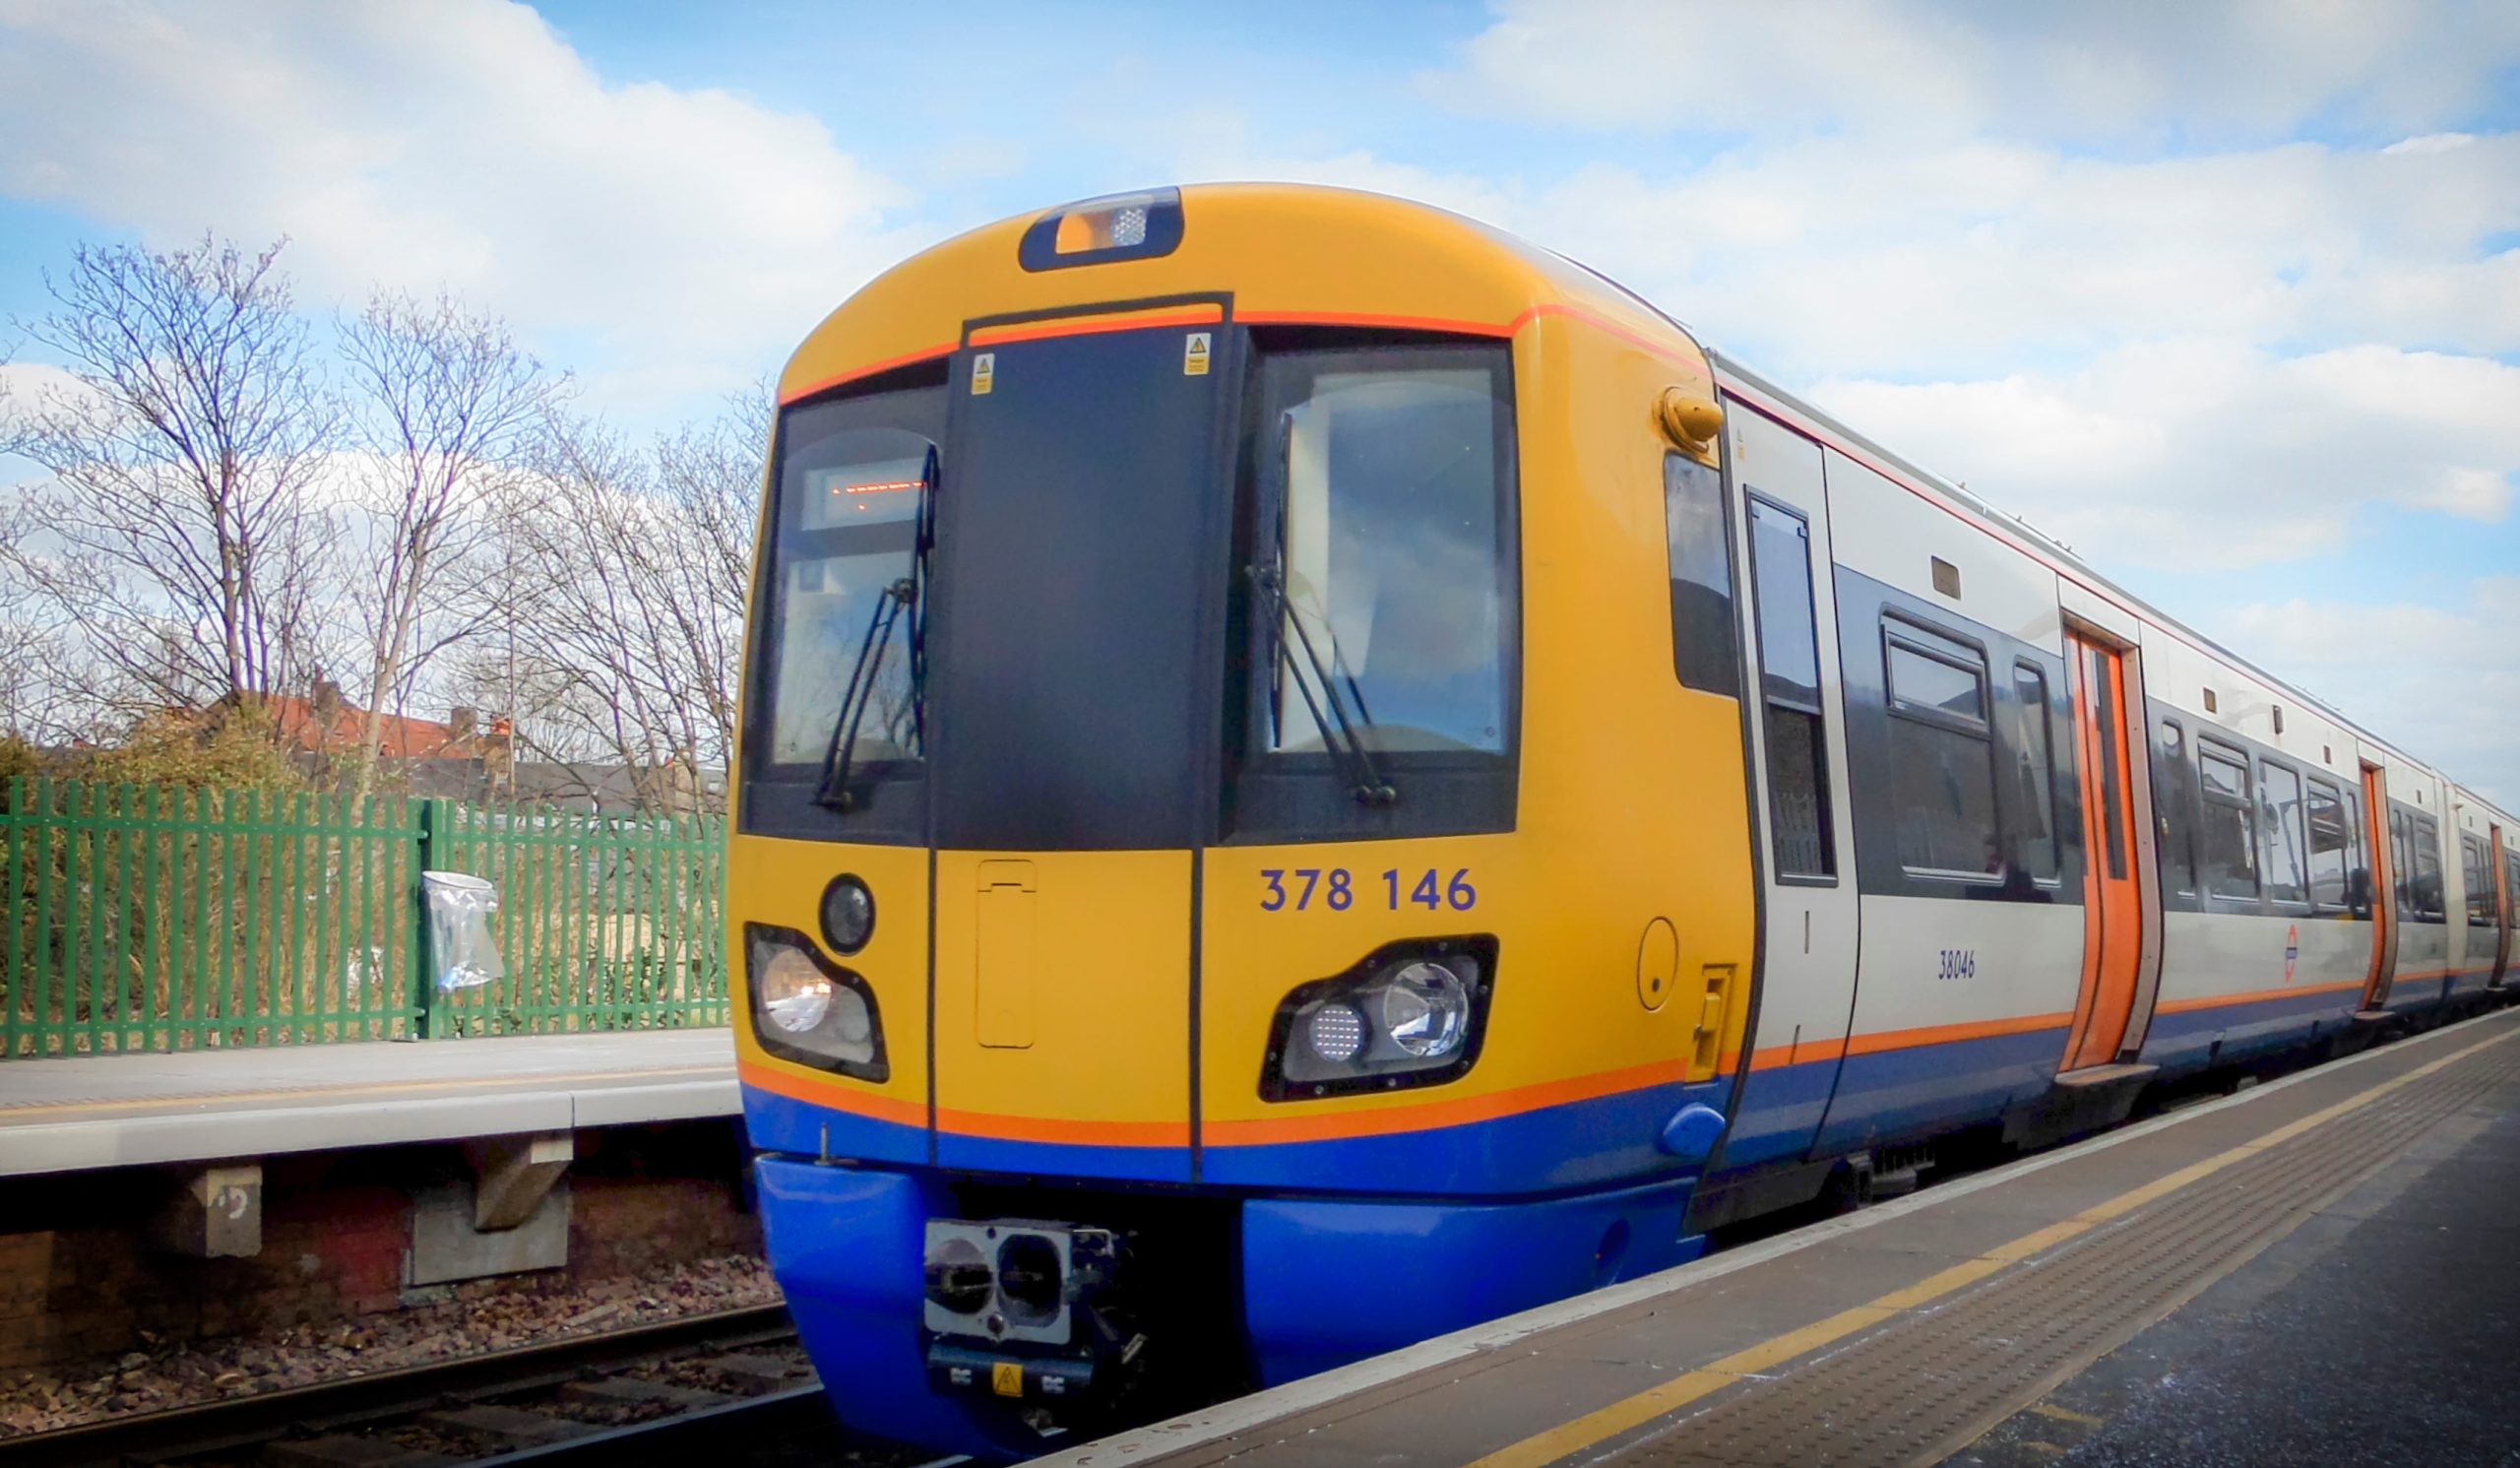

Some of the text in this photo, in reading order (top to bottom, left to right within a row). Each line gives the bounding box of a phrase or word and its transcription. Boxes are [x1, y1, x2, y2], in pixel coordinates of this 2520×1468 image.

[1260, 868, 1477, 912] 378 146
[1938, 949, 1976, 981] 38046
